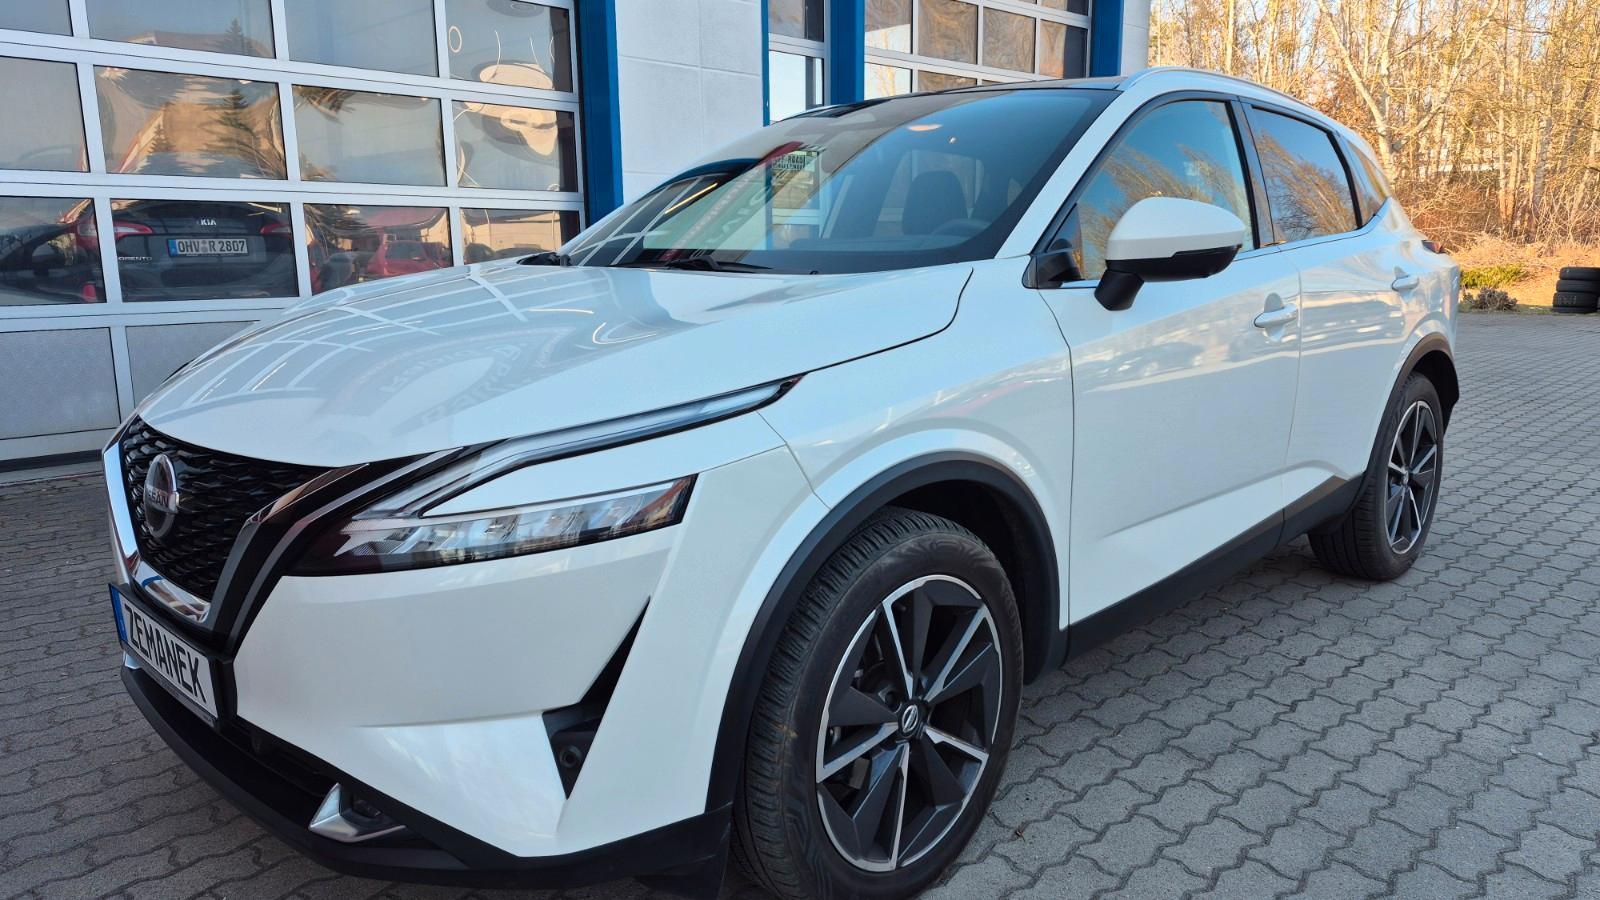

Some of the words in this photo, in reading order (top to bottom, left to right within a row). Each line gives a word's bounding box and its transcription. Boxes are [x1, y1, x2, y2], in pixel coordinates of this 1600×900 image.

[178, 240, 200, 253] OHV
[209, 240, 216, 252] R
[219, 240, 245, 252] 2807
[124, 603, 207, 703] ZEMANEK
